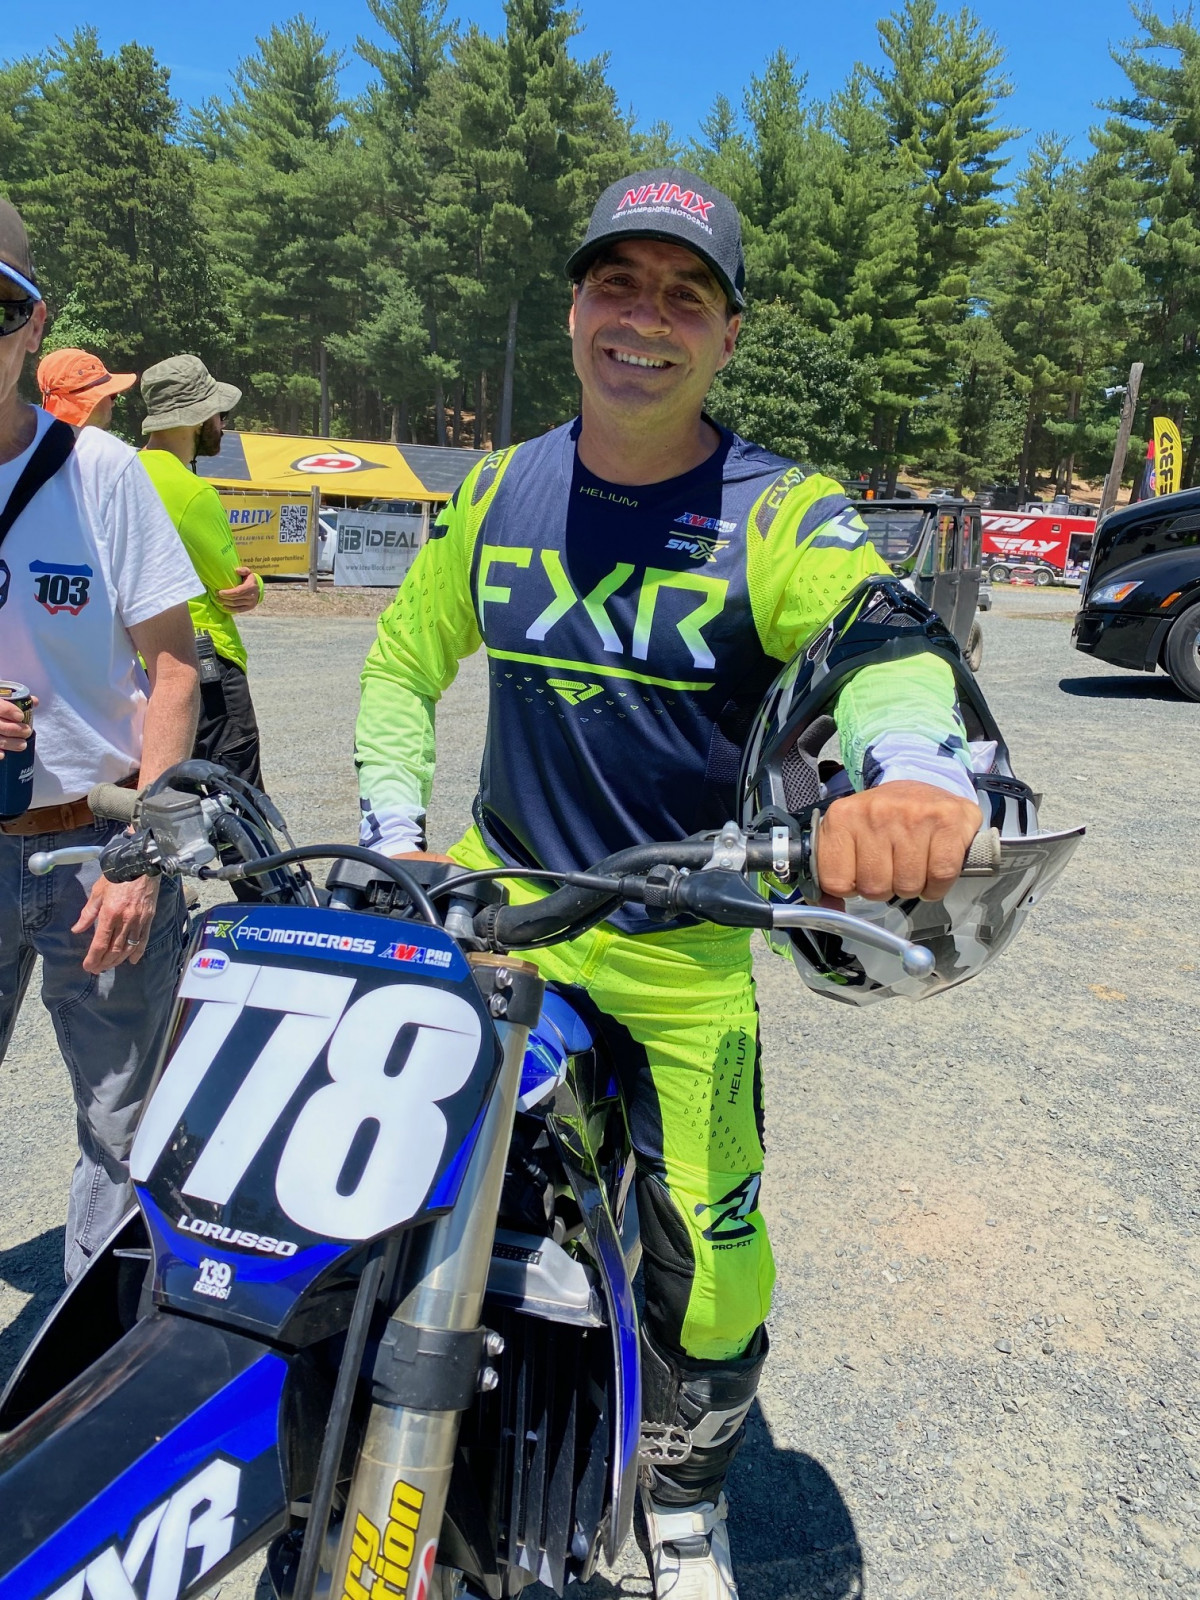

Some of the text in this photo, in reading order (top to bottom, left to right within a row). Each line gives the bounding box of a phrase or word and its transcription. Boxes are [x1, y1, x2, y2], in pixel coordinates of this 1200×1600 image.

[617, 182, 715, 222] NHMX
[612, 206, 713, 235] NEW HAMPSHIRE MOTOCROSS
[579, 485, 639, 508] HELIUM
[225, 509, 274, 525] RRITY
[674, 512, 737, 530] AMA PRO
[981, 515, 1037, 532] TPJ
[365, 529, 419, 548] IDEAL
[990, 536, 1062, 552] FLY
[664, 538, 730, 563] SMX
[1001, 549, 1044, 557] RACING
[34, 574, 90, 606] 103
[477, 544, 730, 669] FXR
[204, 922, 232, 938] SMX
[193, 957, 215, 969] AMA
[378, 942, 453, 964] AMA PRO
[424, 958, 450, 969] RACING
[727, 1026, 747, 1105] HELIUM
[129, 959, 482, 1240] 778
[177, 1214, 299, 1257] LORUSSO
[711, 1238, 755, 1251] PRO-FIT
[199, 1257, 232, 1288] 139
